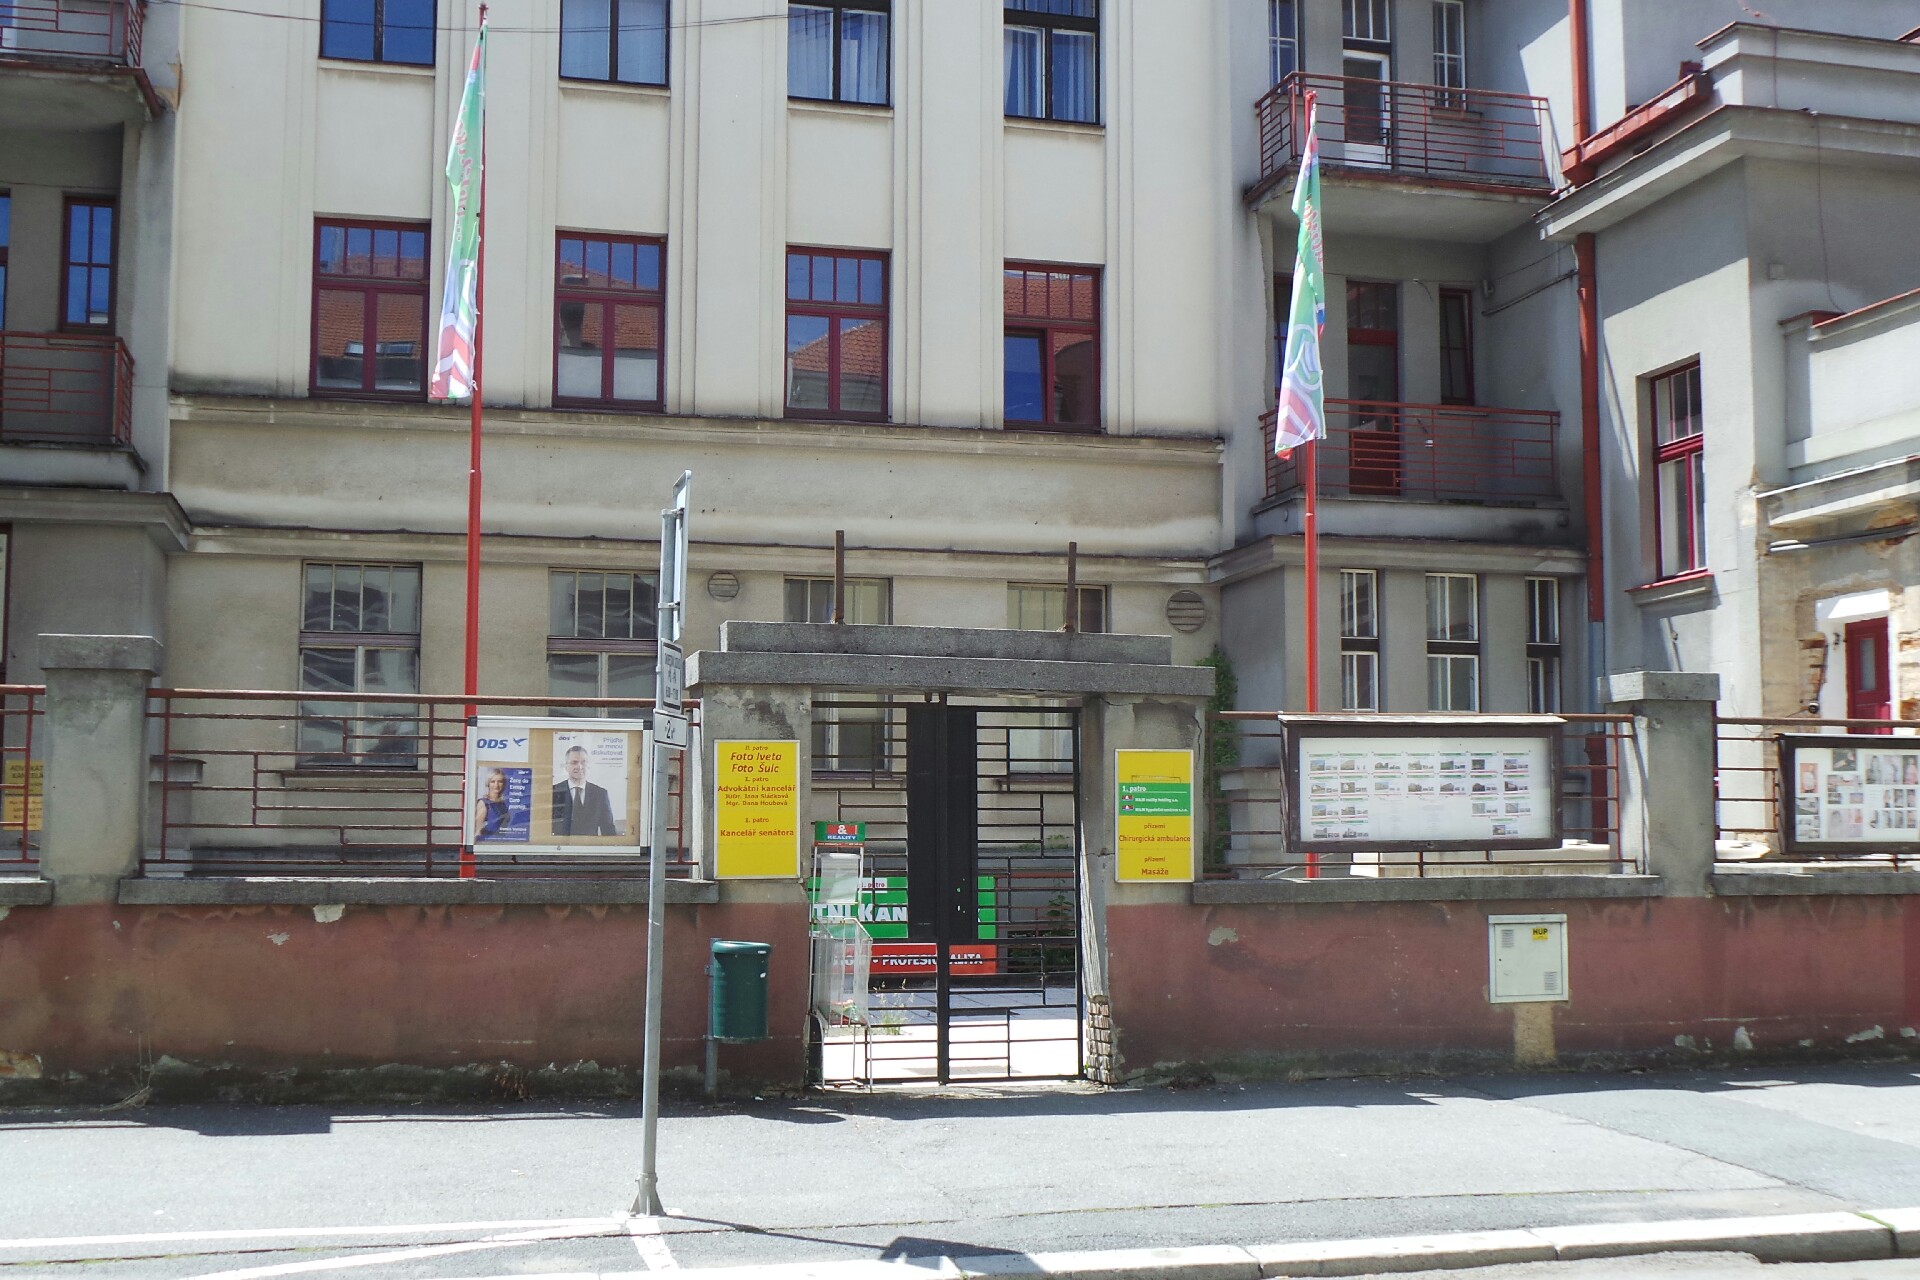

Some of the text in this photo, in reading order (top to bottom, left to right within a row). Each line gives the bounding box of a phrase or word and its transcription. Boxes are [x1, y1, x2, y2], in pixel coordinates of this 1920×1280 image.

[477, 738, 509, 749] ODS
[730, 752, 782, 761] Foto Iveta
[731, 761, 780, 773] Foto Šulc
[1129, 785, 1147, 793] patro
[720, 828, 756, 837] Kancelář
[1118, 834, 1191, 843] Chirurgická ambulance
[1141, 867, 1169, 875] Masáže
[1532, 927, 1549, 936] HUP
